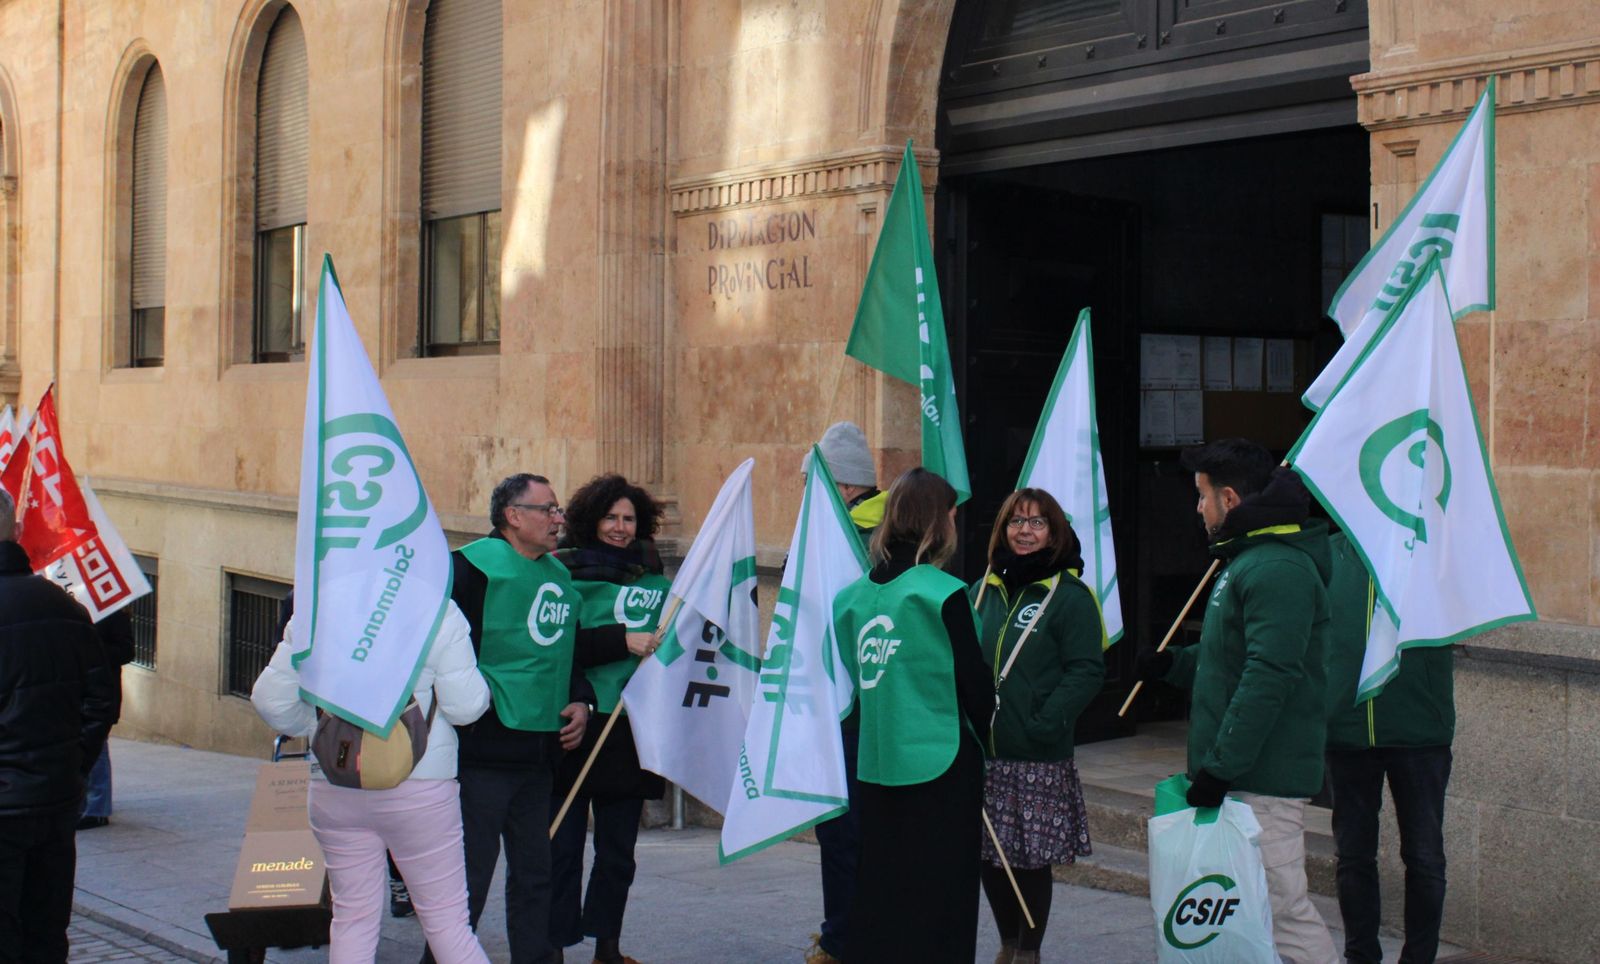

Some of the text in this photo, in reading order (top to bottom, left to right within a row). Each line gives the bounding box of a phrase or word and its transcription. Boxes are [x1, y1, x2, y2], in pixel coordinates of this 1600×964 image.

[539, 601, 570, 625] CSIF
[860, 637, 902, 665] CSIF
[251, 857, 314, 872] menade
[1175, 898, 1240, 926] CSIF
